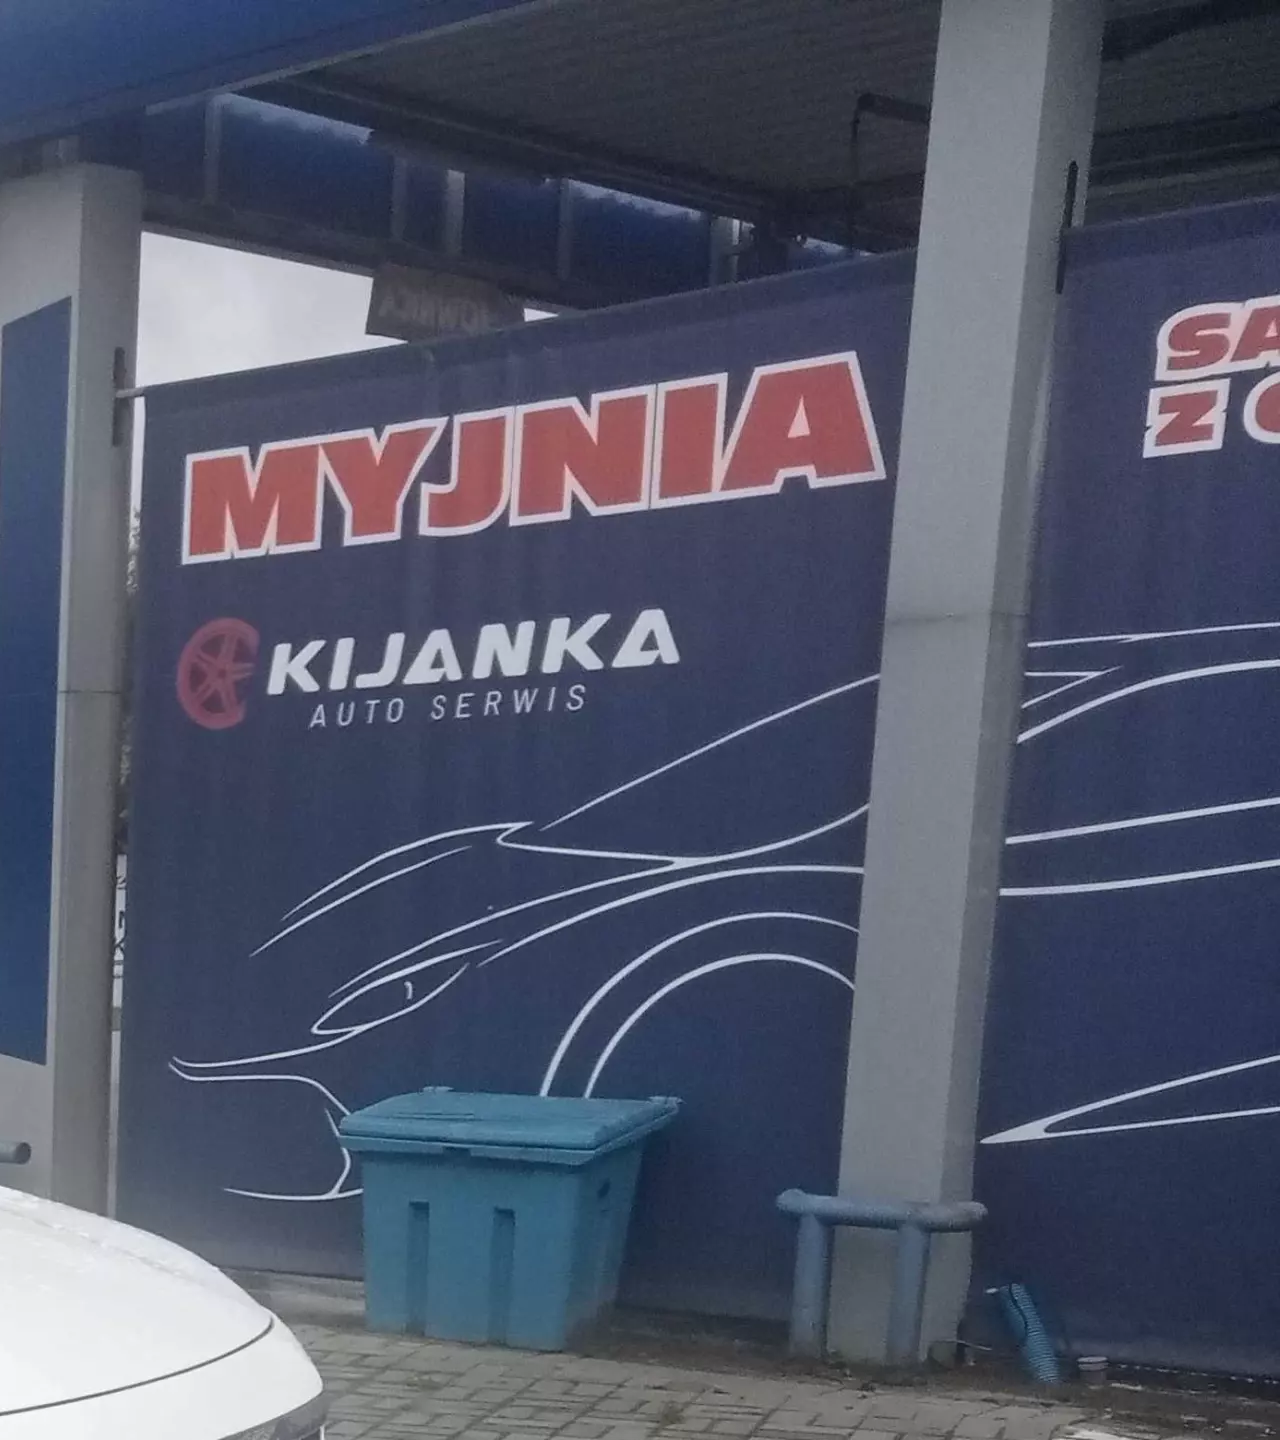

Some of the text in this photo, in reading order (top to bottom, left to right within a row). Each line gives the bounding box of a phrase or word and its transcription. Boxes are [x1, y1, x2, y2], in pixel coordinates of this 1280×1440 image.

[180, 350, 887, 566] MYJNIA
[1143, 377, 1231, 459] Z
[267, 608, 680, 695] KIJANKA
[309, 684, 587, 728] AUTO SERWIS
